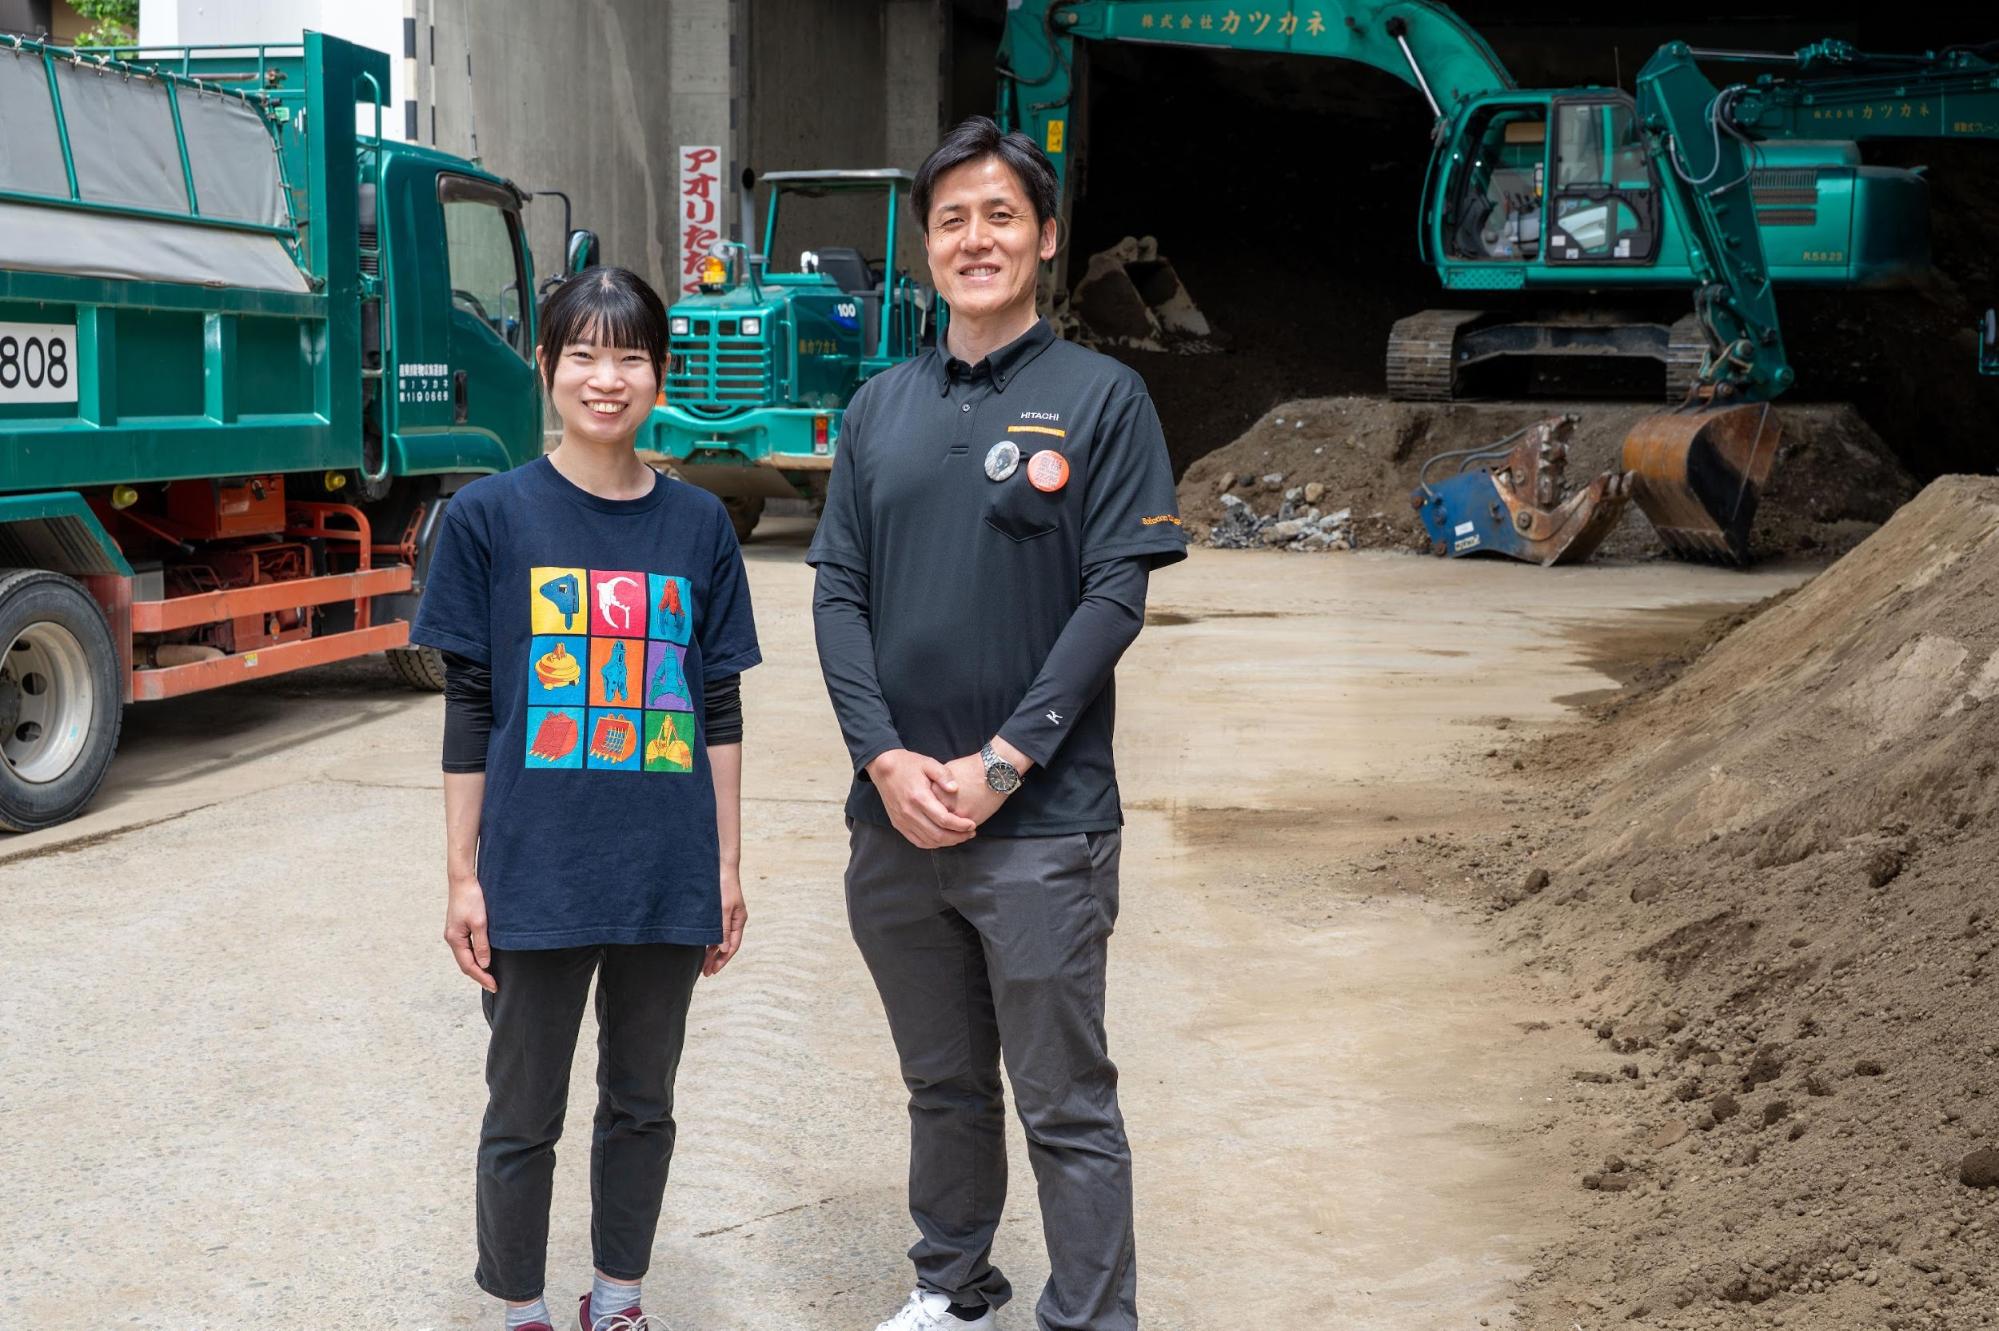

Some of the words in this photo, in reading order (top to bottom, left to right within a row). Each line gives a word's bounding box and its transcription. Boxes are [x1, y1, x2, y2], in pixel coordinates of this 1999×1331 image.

[837, 303, 856, 318] 100
[0, 335, 68, 389] 808
[1020, 411, 1060, 421] HITACHI
